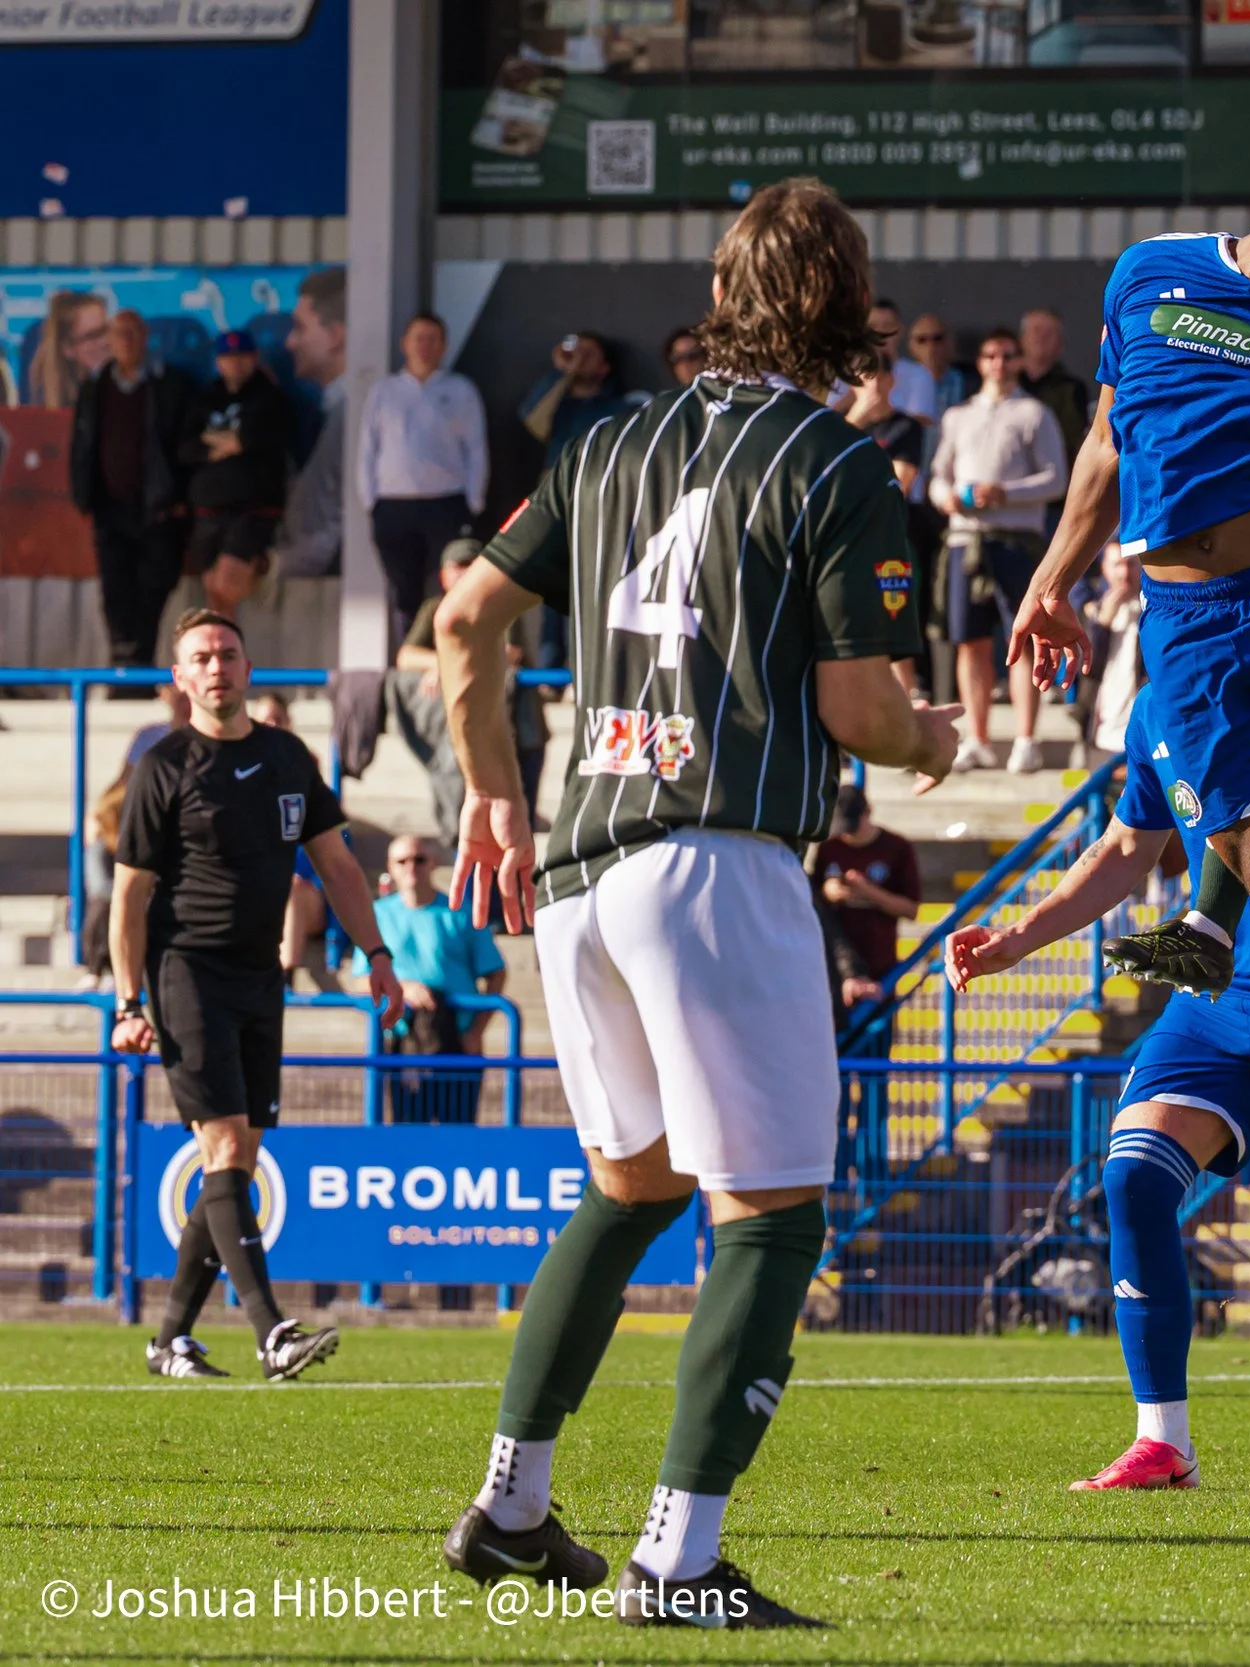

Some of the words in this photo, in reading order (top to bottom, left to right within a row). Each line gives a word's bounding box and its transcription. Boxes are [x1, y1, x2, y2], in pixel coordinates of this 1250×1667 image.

[58, 1, 181, 28] Football
[187, 2, 295, 33] League
[667, 112, 708, 136] The
[764, 111, 861, 138] Building,
[868, 110, 908, 134] 112
[912, 110, 963, 137] High
[968, 109, 1041, 133] Street,
[1166, 337, 1221, 357] Electrical
[607, 488, 709, 668] 4
[309, 1166, 585, 1211] BROMLE
[388, 1225, 539, 1246] SOLICITORS
